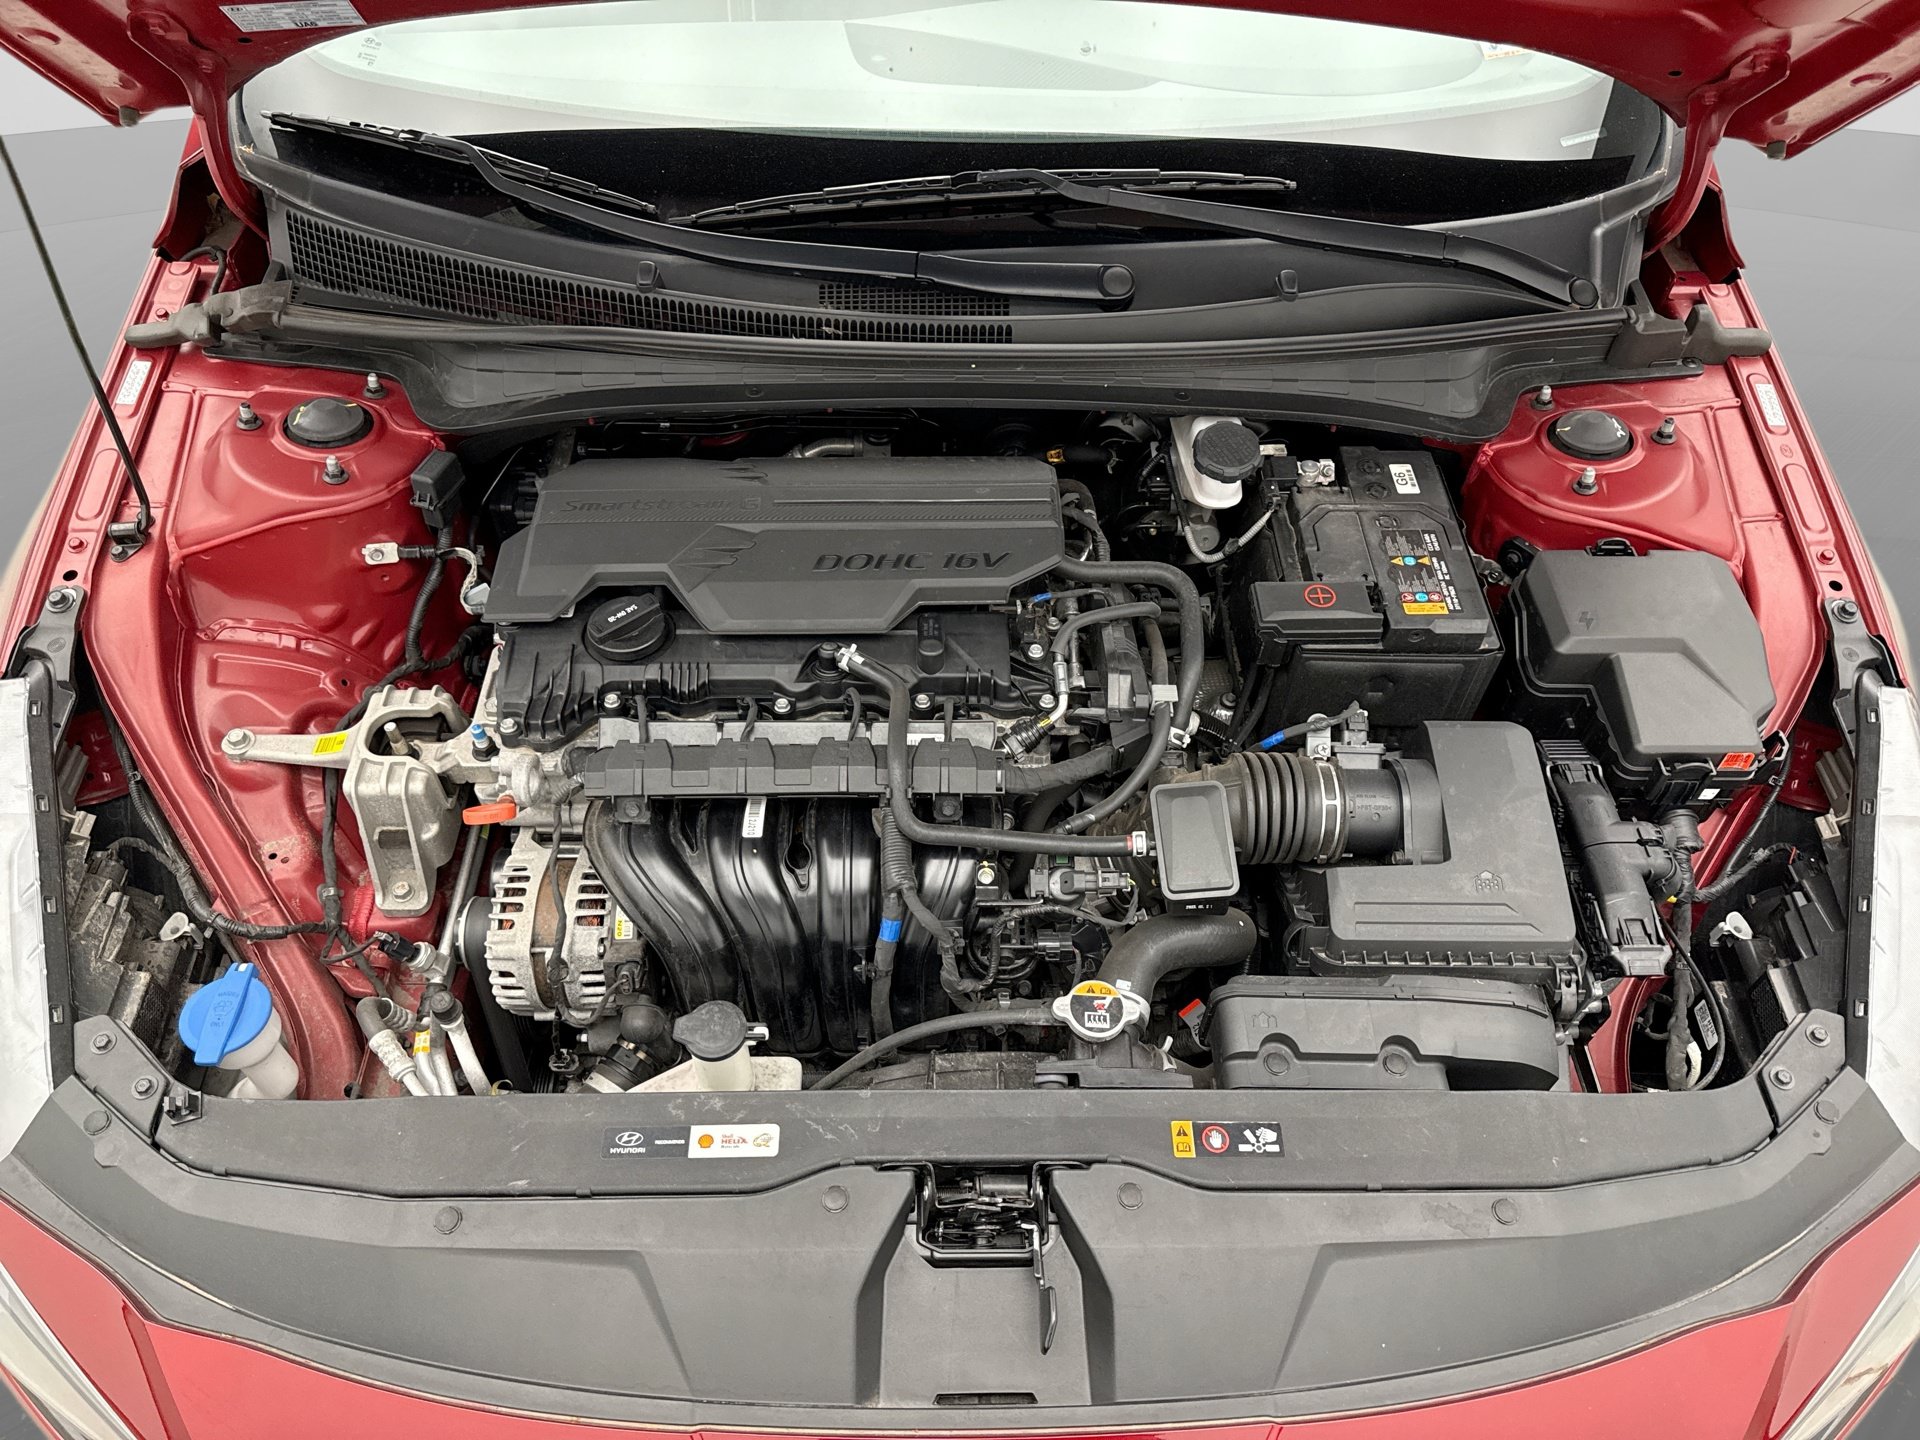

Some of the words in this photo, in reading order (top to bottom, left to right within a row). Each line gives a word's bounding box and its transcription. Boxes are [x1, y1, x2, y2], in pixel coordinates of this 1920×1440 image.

[1394, 472, 1409, 486] G6
[560, 499, 731, 512] Smartstream
[812, 553, 933, 573] DOHC
[942, 552, 1011, 571] 16V
[625, 604, 638, 613] SAE
[608, 610, 627, 622] 0W-20
